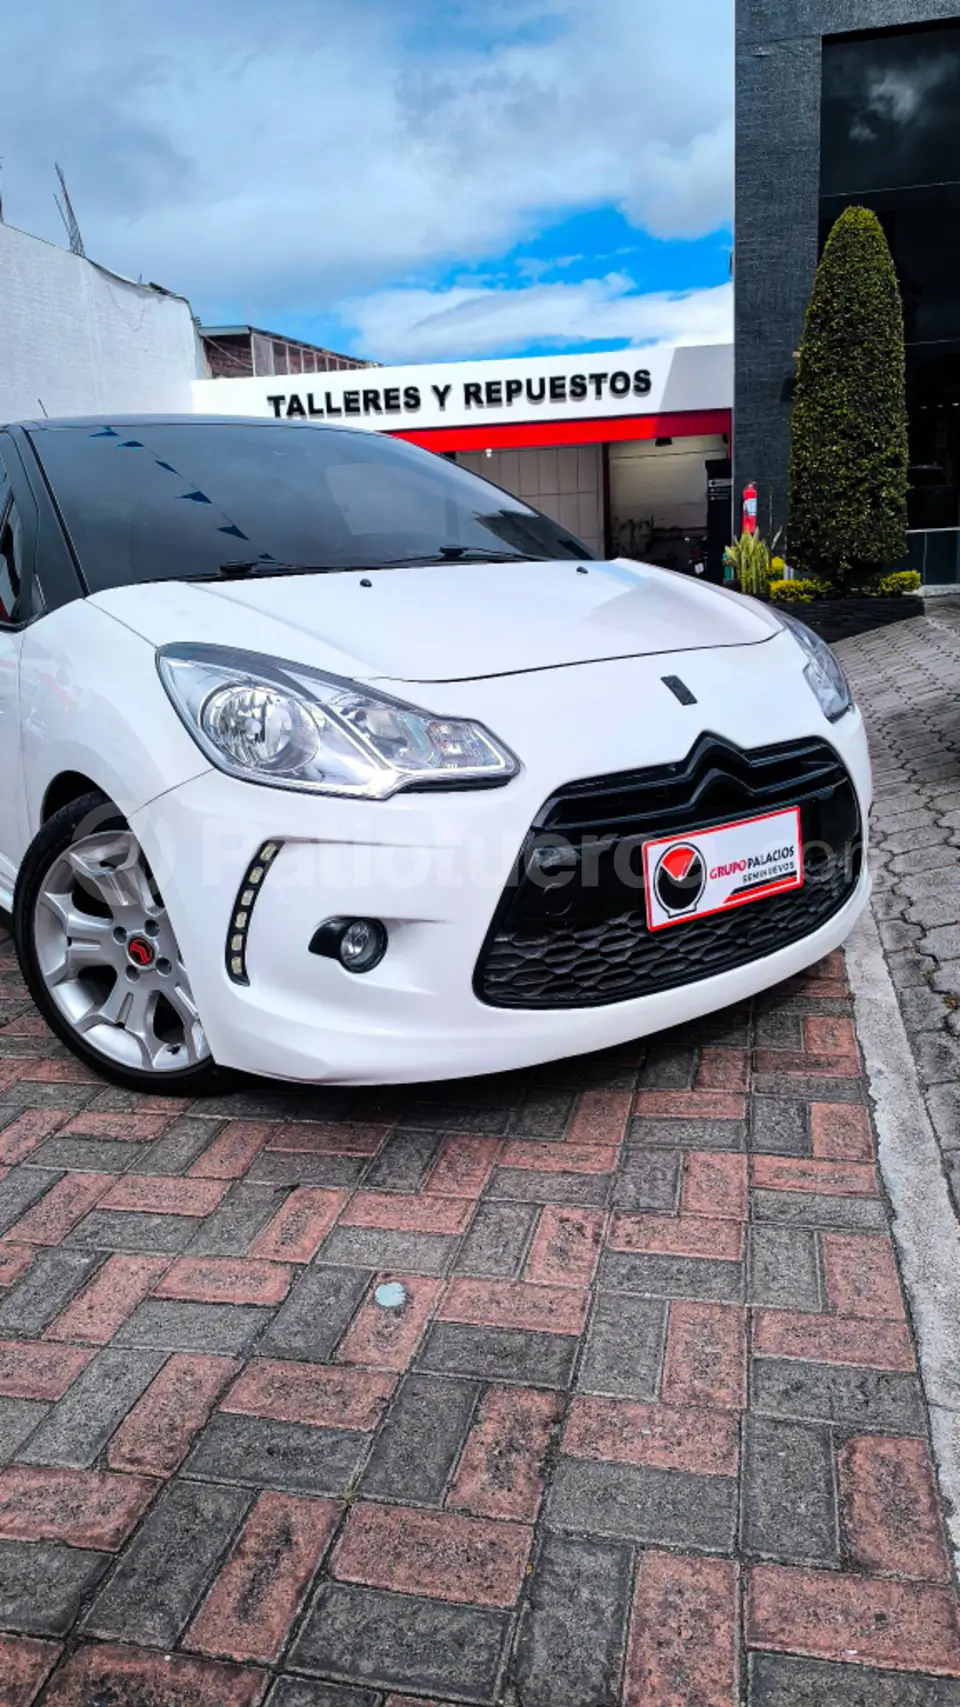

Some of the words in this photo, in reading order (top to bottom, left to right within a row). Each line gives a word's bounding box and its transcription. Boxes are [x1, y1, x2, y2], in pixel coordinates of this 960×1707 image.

[267, 386, 422, 419] TALLERES
[432, 384, 451, 411] Y
[463, 369, 653, 408] REPUESTOS
